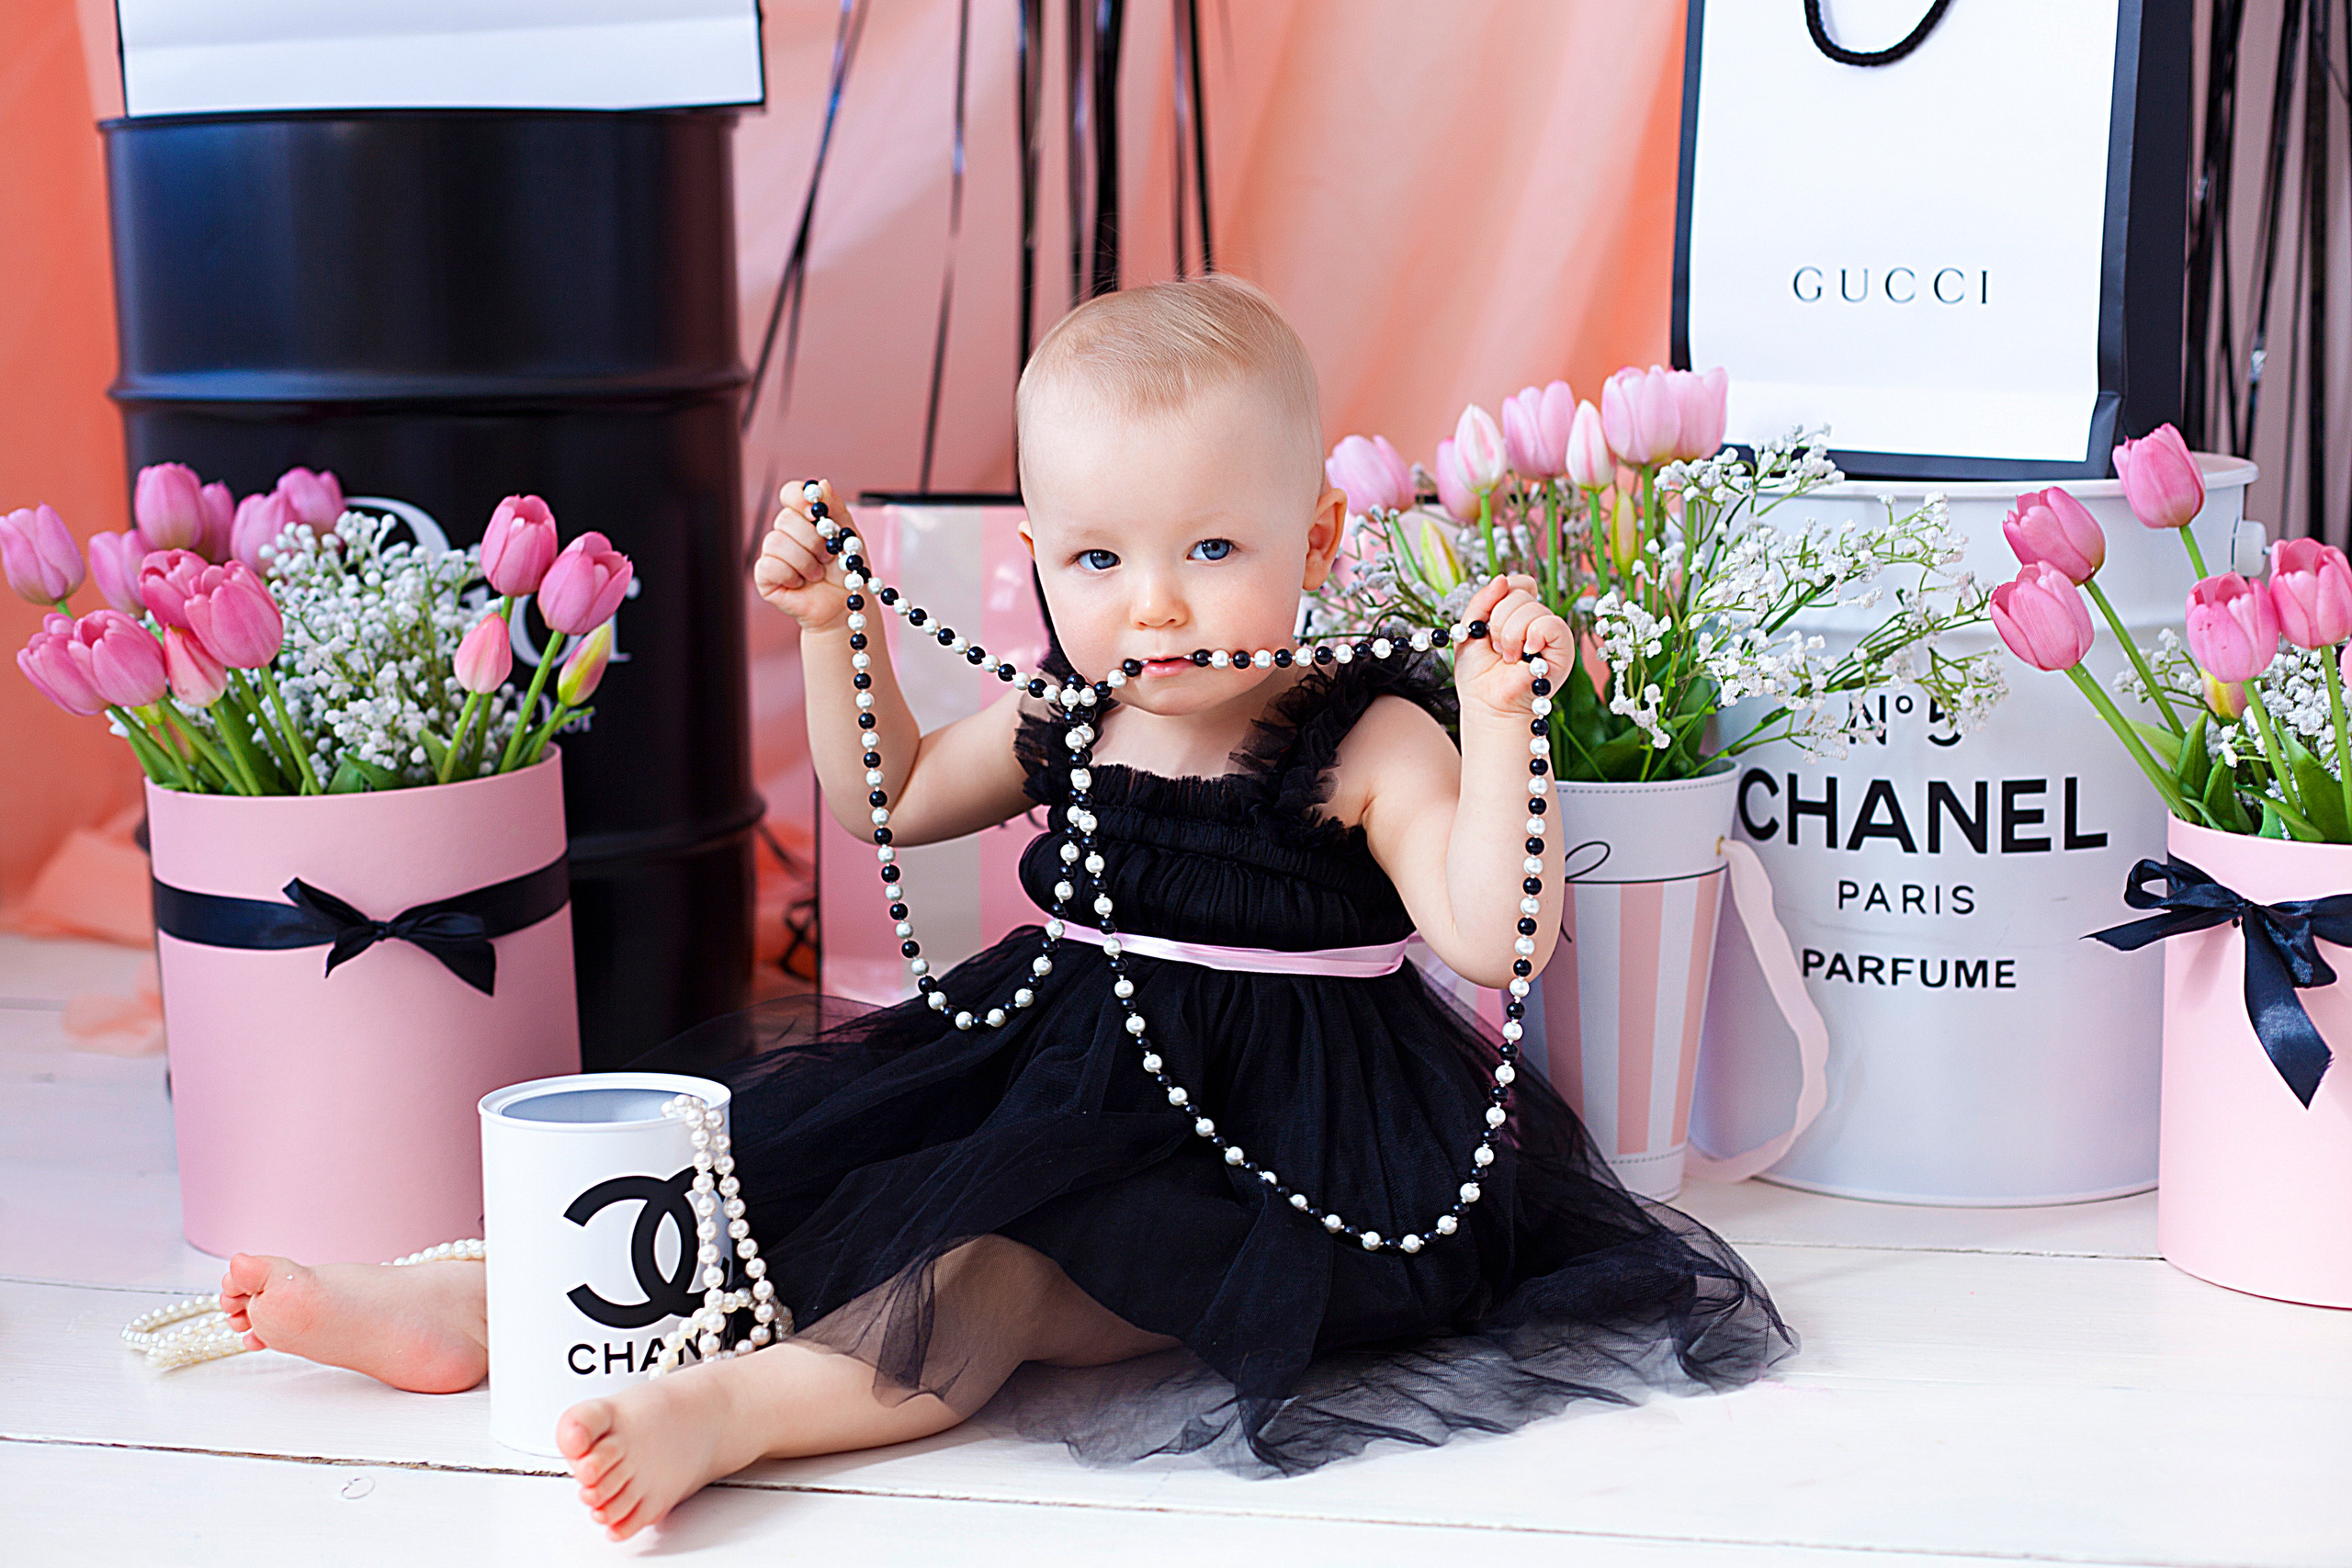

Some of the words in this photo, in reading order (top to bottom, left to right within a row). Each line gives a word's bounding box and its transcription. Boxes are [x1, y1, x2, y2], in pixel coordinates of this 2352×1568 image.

[1793, 265, 1987, 304] GUCCI
[1737, 768, 2109, 854] CHANEL
[1838, 880, 1974, 915] PARIS
[1803, 948, 2017, 988] PARFUME
[568, 1327, 704, 1376] CHAN
